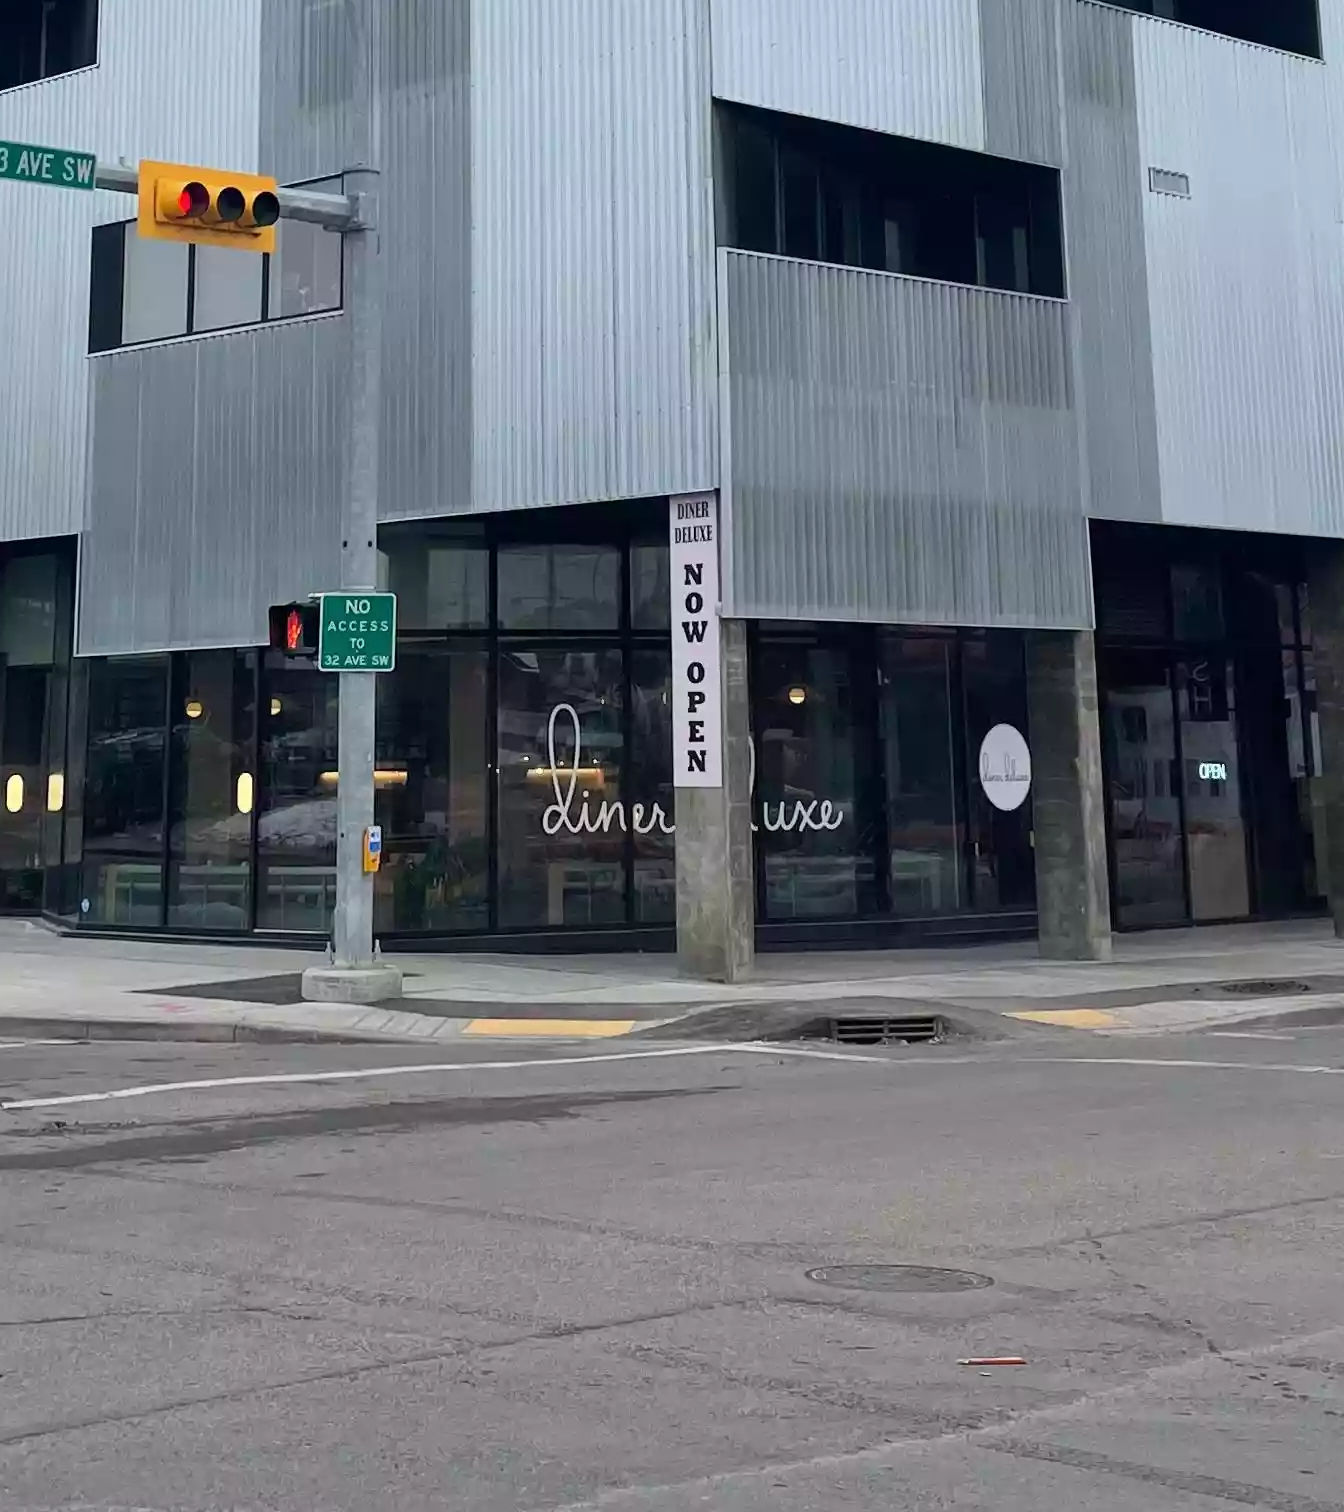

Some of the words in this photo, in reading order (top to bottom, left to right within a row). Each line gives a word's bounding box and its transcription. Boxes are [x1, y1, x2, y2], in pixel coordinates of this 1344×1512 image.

[16, 150, 54, 179] AVE
[62, 156, 93, 184] SW
[677, 501, 709, 520] DINER
[674, 525, 712, 544] DELUXE
[345, 599, 371, 614] NO
[682, 563, 708, 643] NOW
[327, 620, 389, 632] ACCESS
[349, 638, 365, 649] TO
[324, 655, 340, 666] 32
[344, 655, 368, 666] AVE
[371, 655, 389, 666] SW
[687, 661, 707, 773] OPEN
[542, 703, 676, 835] diner
[1198, 762, 1227, 781] OPEN
